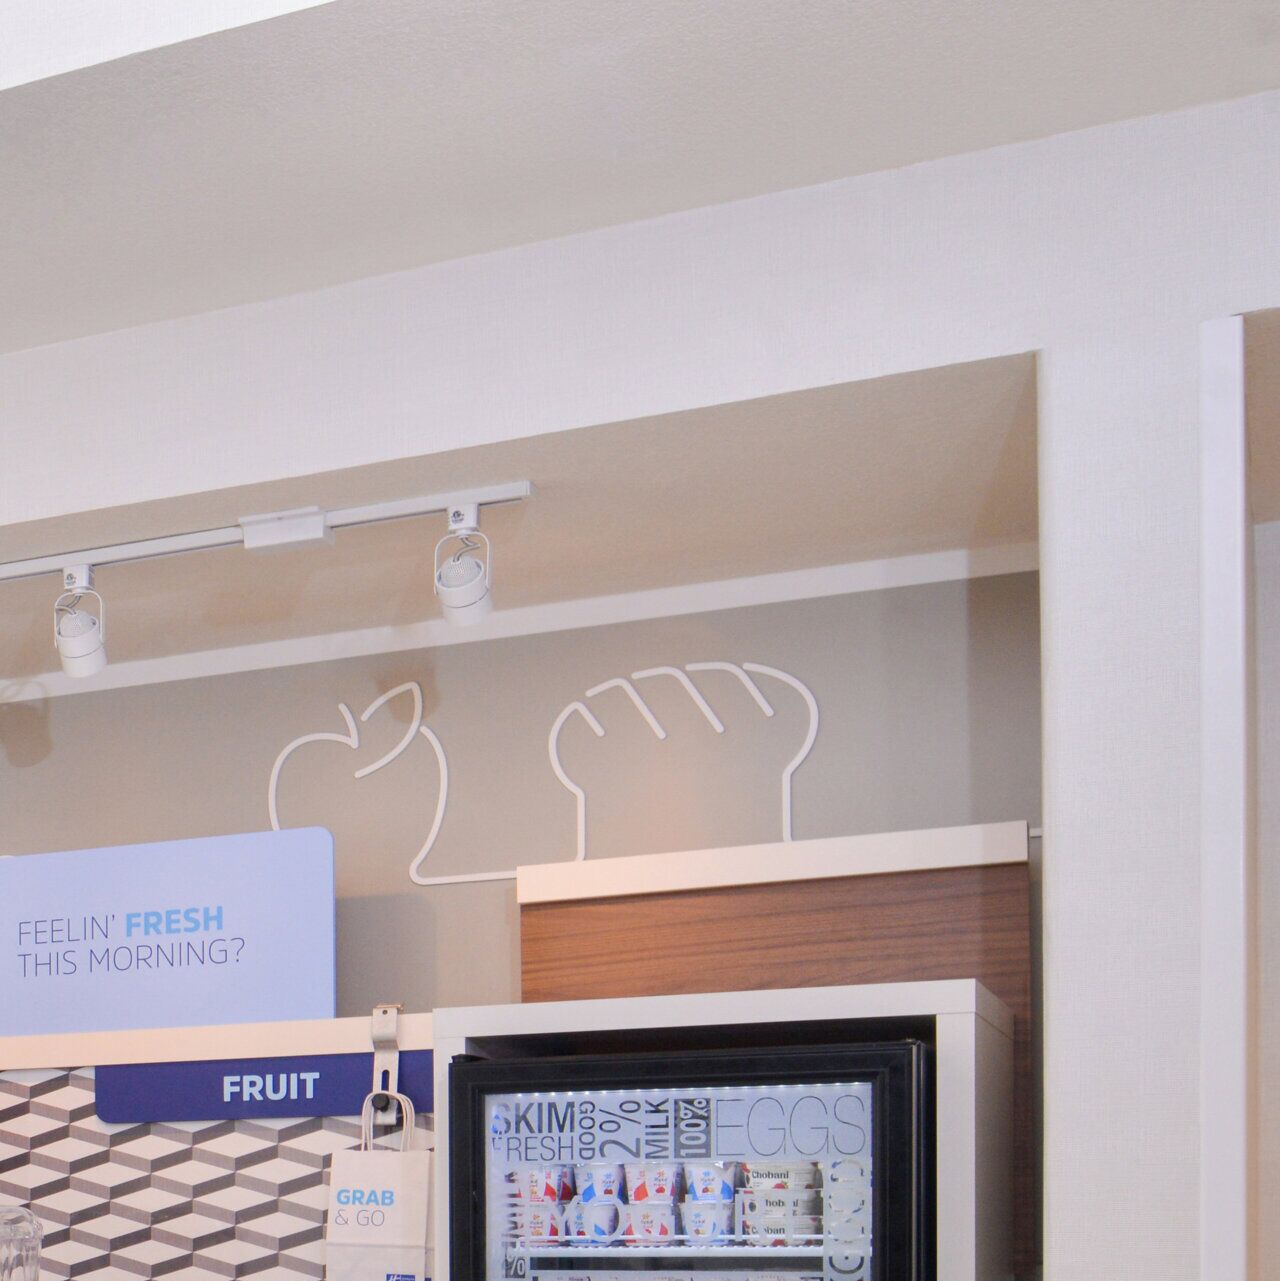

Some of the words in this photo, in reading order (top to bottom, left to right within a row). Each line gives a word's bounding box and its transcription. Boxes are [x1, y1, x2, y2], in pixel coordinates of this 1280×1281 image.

[18, 914, 115, 945] FEELIN'
[125, 906, 224, 937] FRESH
[17, 950, 77, 977] THIS
[89, 937, 246, 973] MORNING?
[223, 1072, 320, 1101] FRUIT
[492, 1101, 575, 1135] SKIM
[579, 1101, 596, 1160] GOOD
[599, 1100, 641, 1158] 2%
[645, 1098, 670, 1159] MILK
[679, 1097, 707, 1158] 100%
[716, 1094, 866, 1157] EGGS
[492, 1136, 575, 1162] FRESH
[752, 1170, 789, 1180] Chobani
[336, 1188, 395, 1207] GRAB
[335, 1208, 350, 1226] &
[356, 1209, 386, 1227] GO
